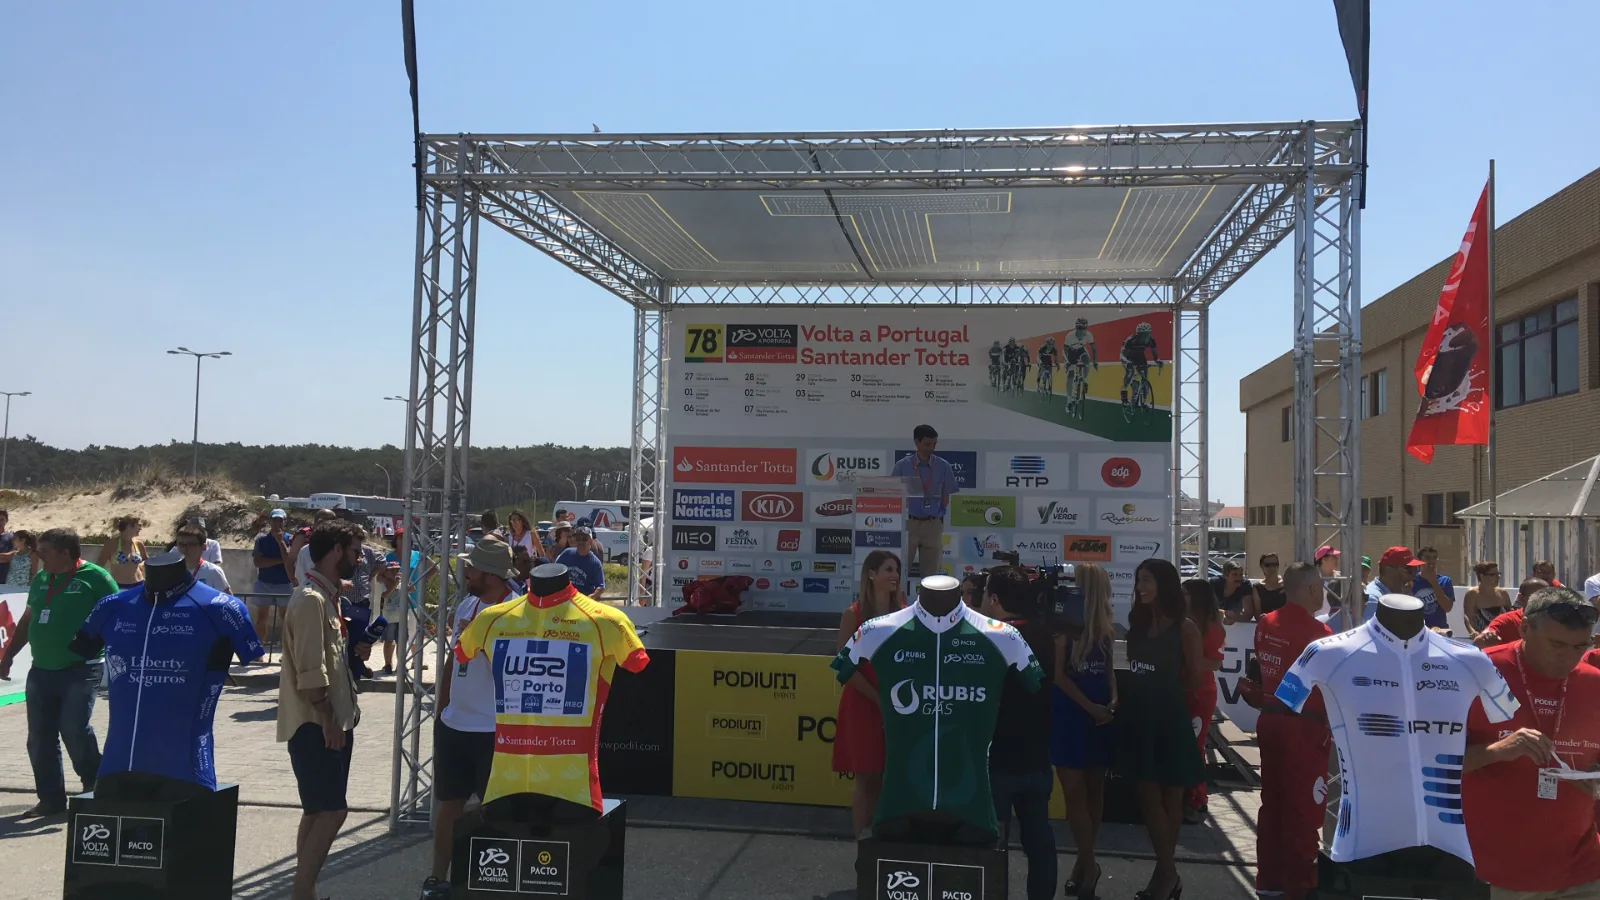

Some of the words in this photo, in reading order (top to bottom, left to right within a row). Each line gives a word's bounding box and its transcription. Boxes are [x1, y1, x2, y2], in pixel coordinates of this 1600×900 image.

[758, 328, 792, 338] VOLTA
[801, 324, 854, 342] Volta
[860, 329, 872, 342] a
[878, 324, 969, 348] Portugal
[738, 350, 776, 360] Santander
[776, 352, 794, 360] Totta
[800, 348, 910, 366] Santander
[914, 349, 970, 366] Totta
[696, 460, 758, 473] Santander
[760, 462, 793, 474] Totta
[1111, 467, 1130, 478] edp
[1006, 476, 1049, 488] RTP
[676, 492, 712, 505] Jornal
[714, 492, 732, 505] de
[676, 505, 732, 518] Notícias
[757, 499, 787, 514] KIA
[676, 532, 712, 544] MEO
[725, 537, 758, 546] FESTINA
[1069, 539, 1107, 553] KTM
[229, 599, 246, 625] Liberty
[1320, 630, 1356, 645] RTP
[1381, 632, 1394, 643] RTP
[131, 656, 185, 672] Liberty
[128, 673, 186, 686] Seguros
[1373, 679, 1399, 687] RTP
[505, 679, 520, 691] FC
[523, 680, 563, 693] Porto
[505, 735, 548, 746] Santander
[550, 737, 576, 746] Totta
[598, 741, 660, 752] ww.podi1.com
[82, 842, 109, 852] VOLTA
[128, 841, 153, 850] PACTO
[479, 867, 508, 877] VOLTA
[530, 866, 558, 876] PACTO
[887, 891, 919, 900] VOLTA
[942, 891, 971, 900] PACTO
